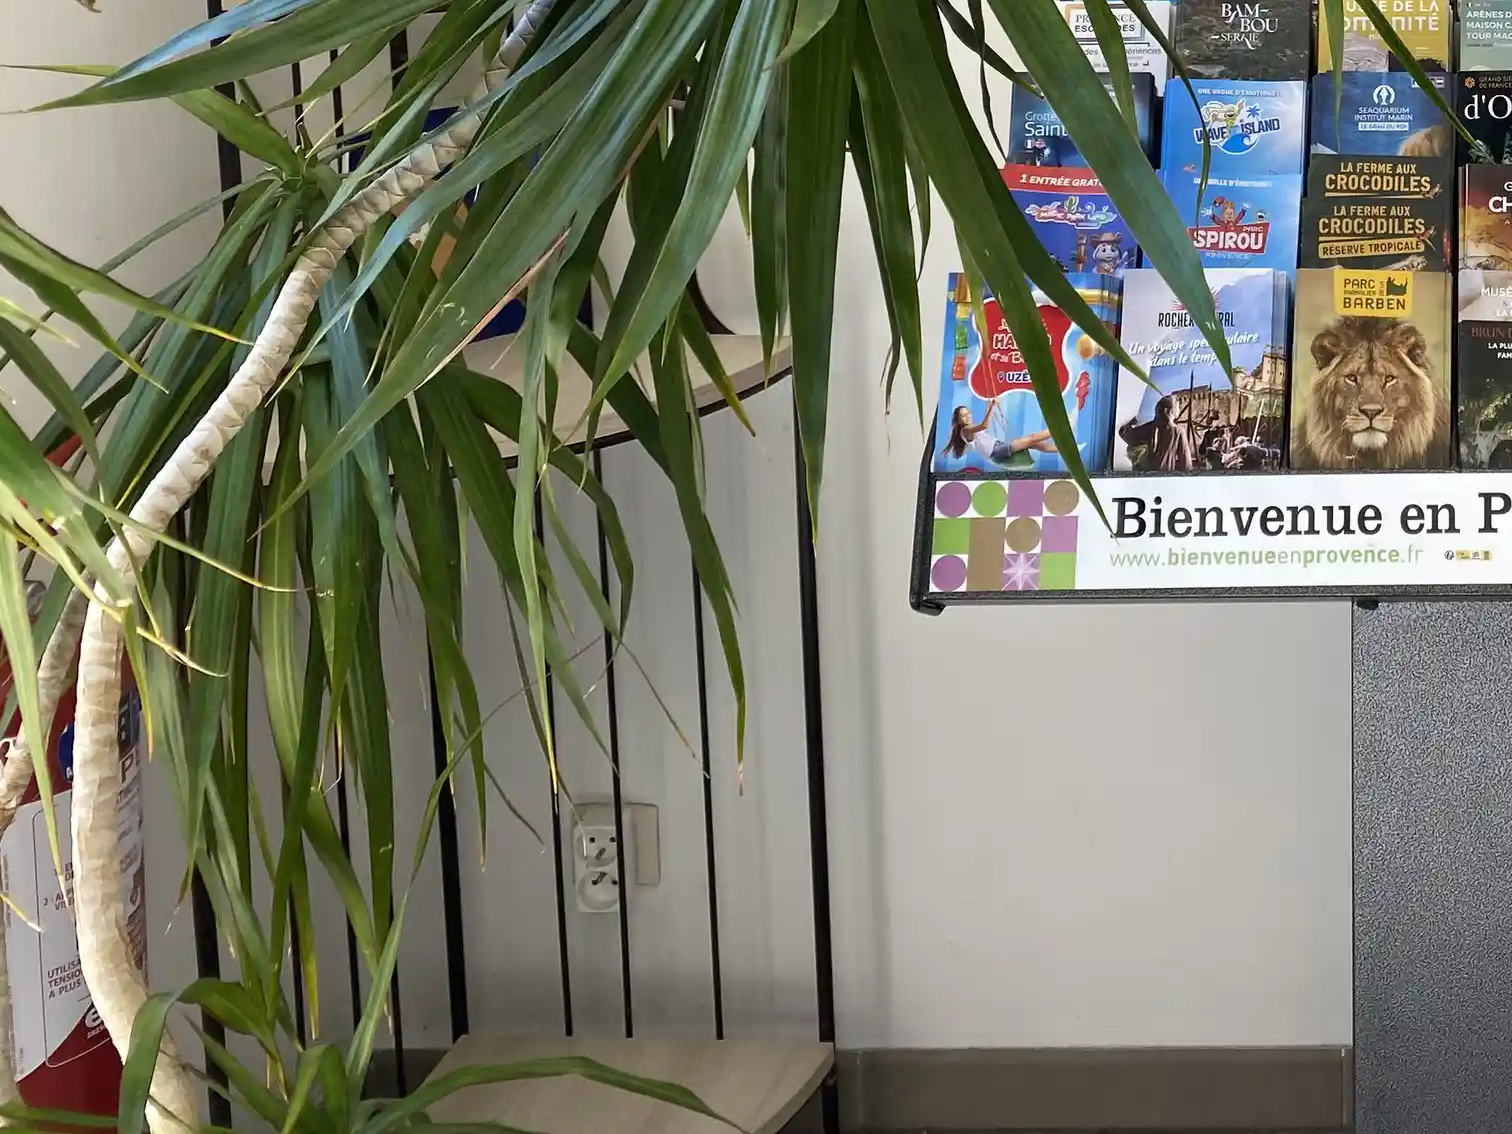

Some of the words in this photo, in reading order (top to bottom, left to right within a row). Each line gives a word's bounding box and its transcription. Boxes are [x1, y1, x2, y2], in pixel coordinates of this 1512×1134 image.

[1466, 32, 1492, 40] TOUR
[1340, 163, 1353, 172] LA
[1356, 163, 1393, 174] FERME
[1396, 163, 1417, 174] AUX
[1325, 174, 1431, 192] CROCODILES
[1334, 206, 1347, 216] LA
[1350, 206, 1387, 216] FERME
[1390, 206, 1411, 216] AUX
[1318, 218, 1425, 235] CROCODILES
[1343, 297, 1406, 310] BARBEN
[1110, 496, 1383, 539] Bienvenue
[1400, 502, 1461, 535] en
[1109, 545, 1424, 568] www.bienvenueenprovence.fr
